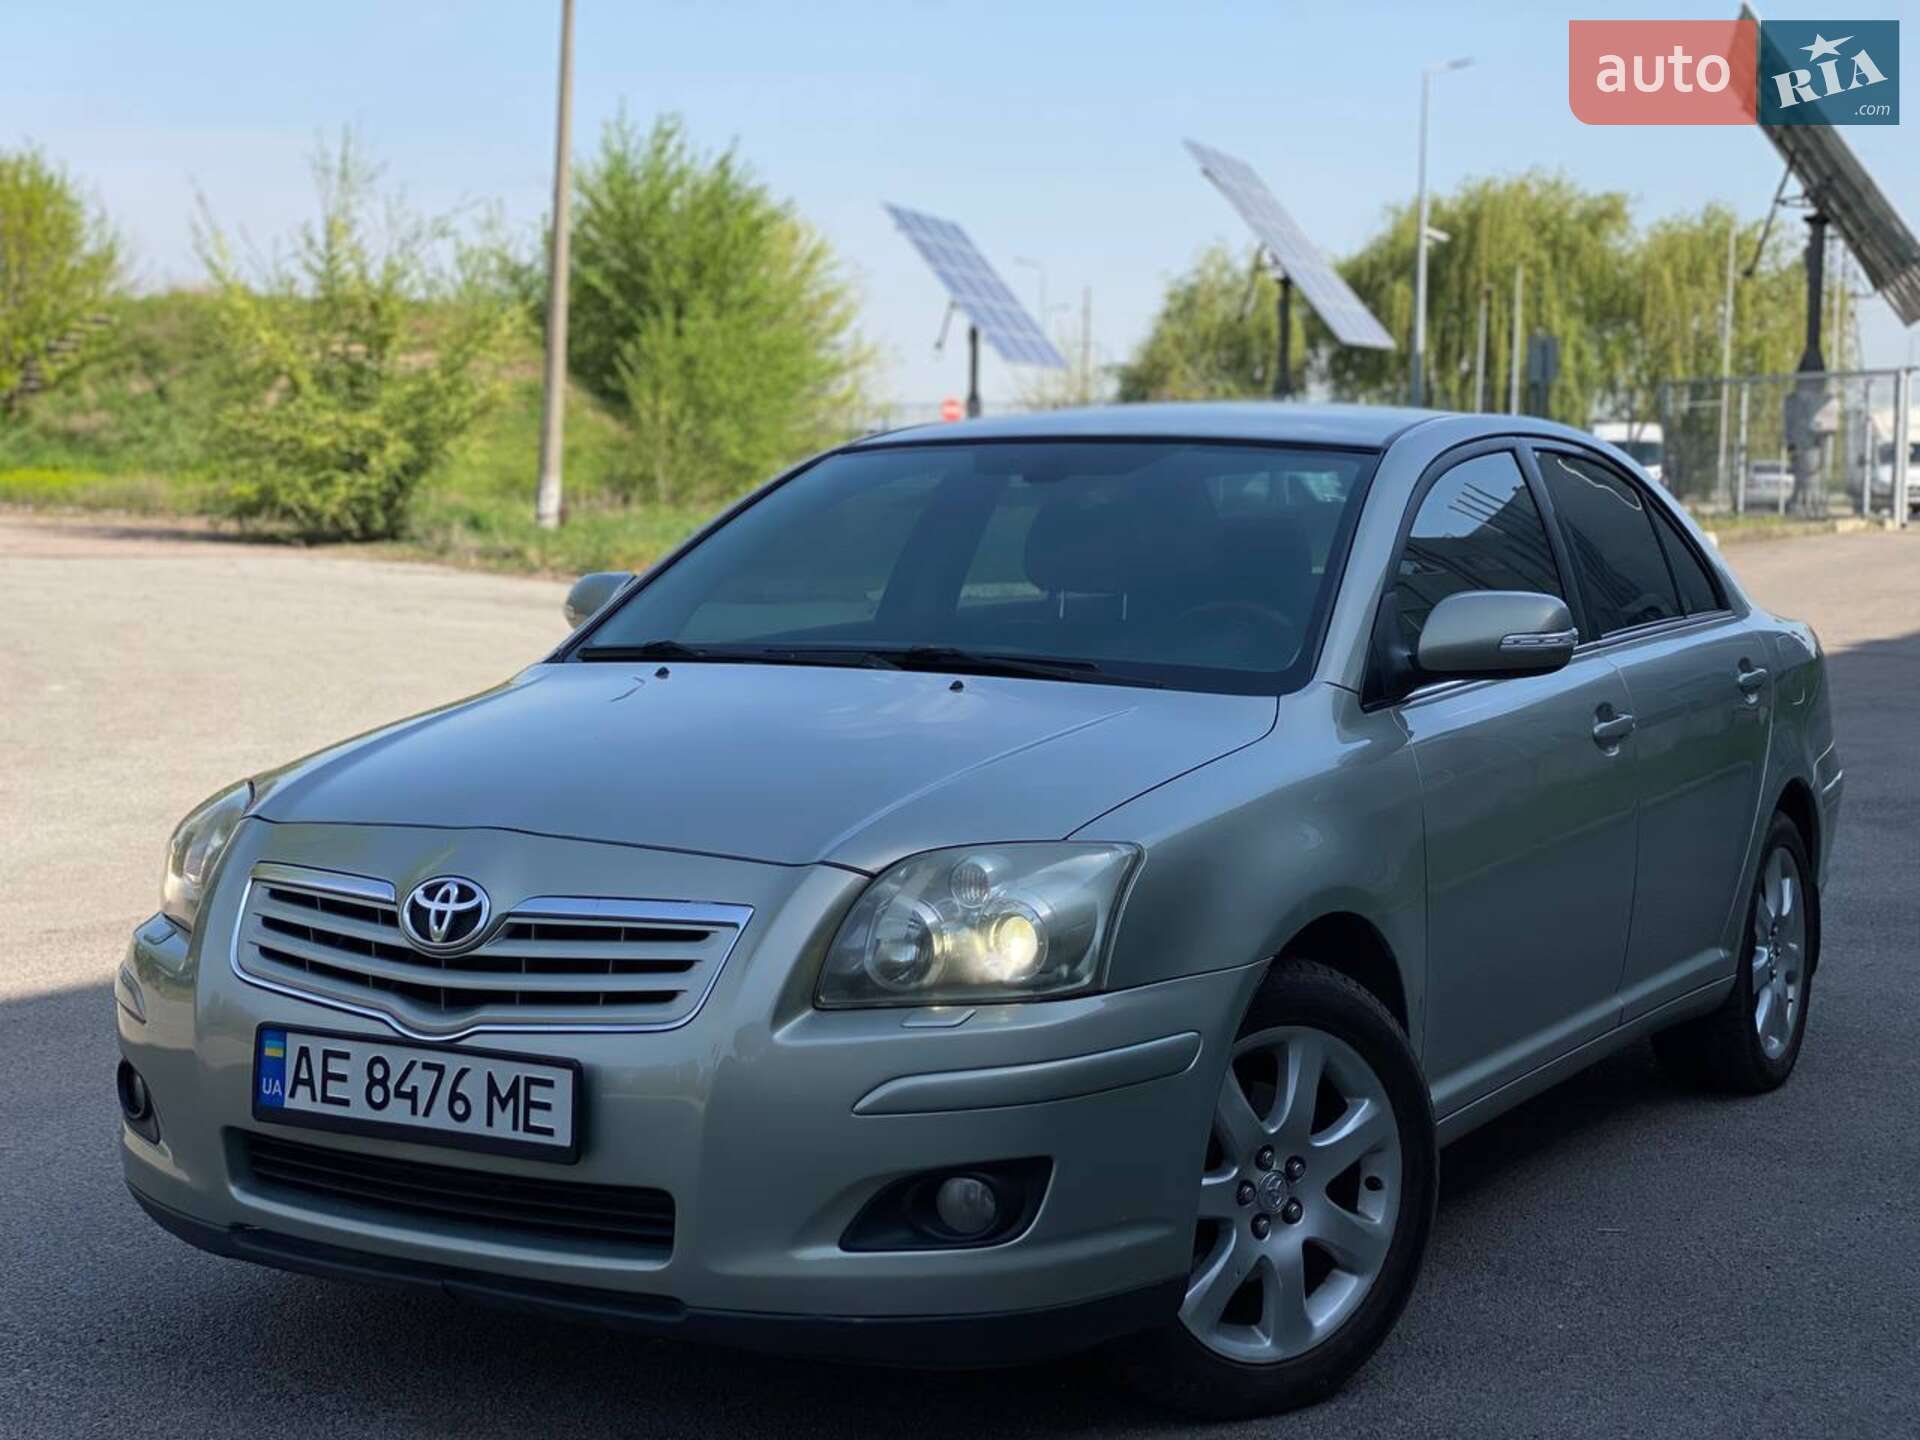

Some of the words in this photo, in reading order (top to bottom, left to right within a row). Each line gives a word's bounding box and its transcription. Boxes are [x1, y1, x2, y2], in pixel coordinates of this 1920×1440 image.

[262, 1079, 283, 1097] UA
[288, 1045, 351, 1107] AE
[364, 1055, 473, 1123] 8476
[486, 1070, 555, 1137] ME
